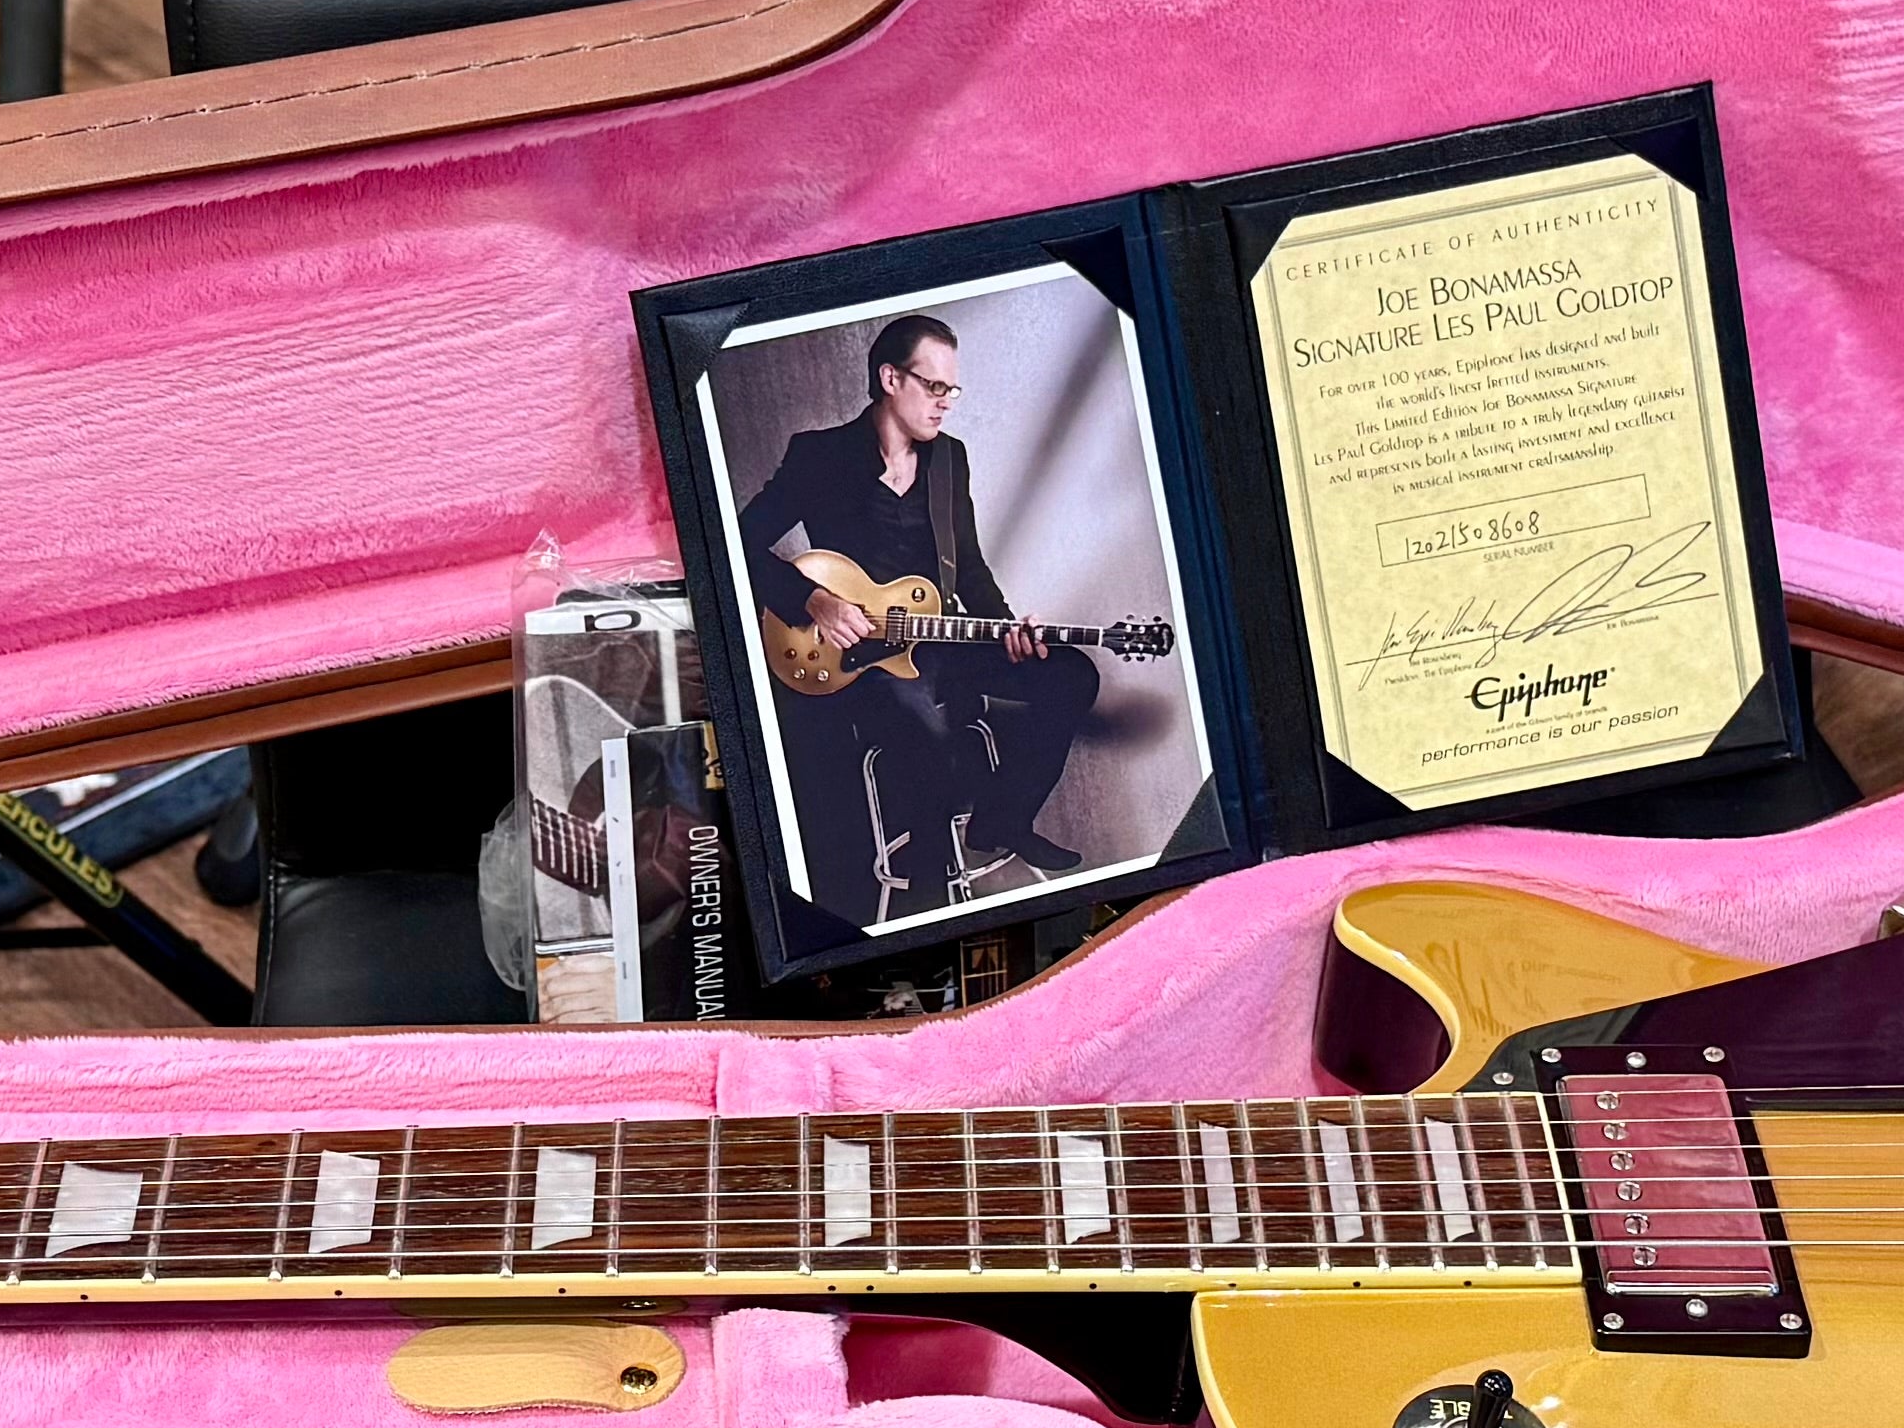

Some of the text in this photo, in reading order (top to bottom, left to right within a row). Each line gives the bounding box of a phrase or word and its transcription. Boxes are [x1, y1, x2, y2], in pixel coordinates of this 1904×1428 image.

[1285, 197, 1657, 281] CERTIFICATE OF AUTHENTICITY
[1376, 257, 1582, 317] JOE BONAMASSA
[1292, 275, 1674, 368] SIGNATURE LES PAUL GOLDTOP
[1318, 383, 1343, 399] For
[1346, 379, 1376, 394] over
[1381, 369, 1410, 388] 100
[1455, 352, 1514, 375] Epiphone
[1518, 345, 1542, 361] has
[1544, 331, 1599, 356] designed
[1602, 326, 1627, 345] and
[1629, 321, 1660, 340] built
[1354, 420, 1380, 437] This
[1431, 403, 1478, 422] Edition
[1398, 384, 1446, 405] world's
[1328, 466, 1352, 485] and
[1586, 417, 1610, 436] and
[1336, 441, 1365, 462] Paul
[1368, 434, 1424, 456] Goldtop
[1427, 433, 1438, 445] is
[1462, 662, 1608, 723] Epiphone
[1420, 704, 1679, 767] performance is our passion
[688, 825, 722, 927] OWNER'S
[1429, 1398, 1514, 1420] TBLE
